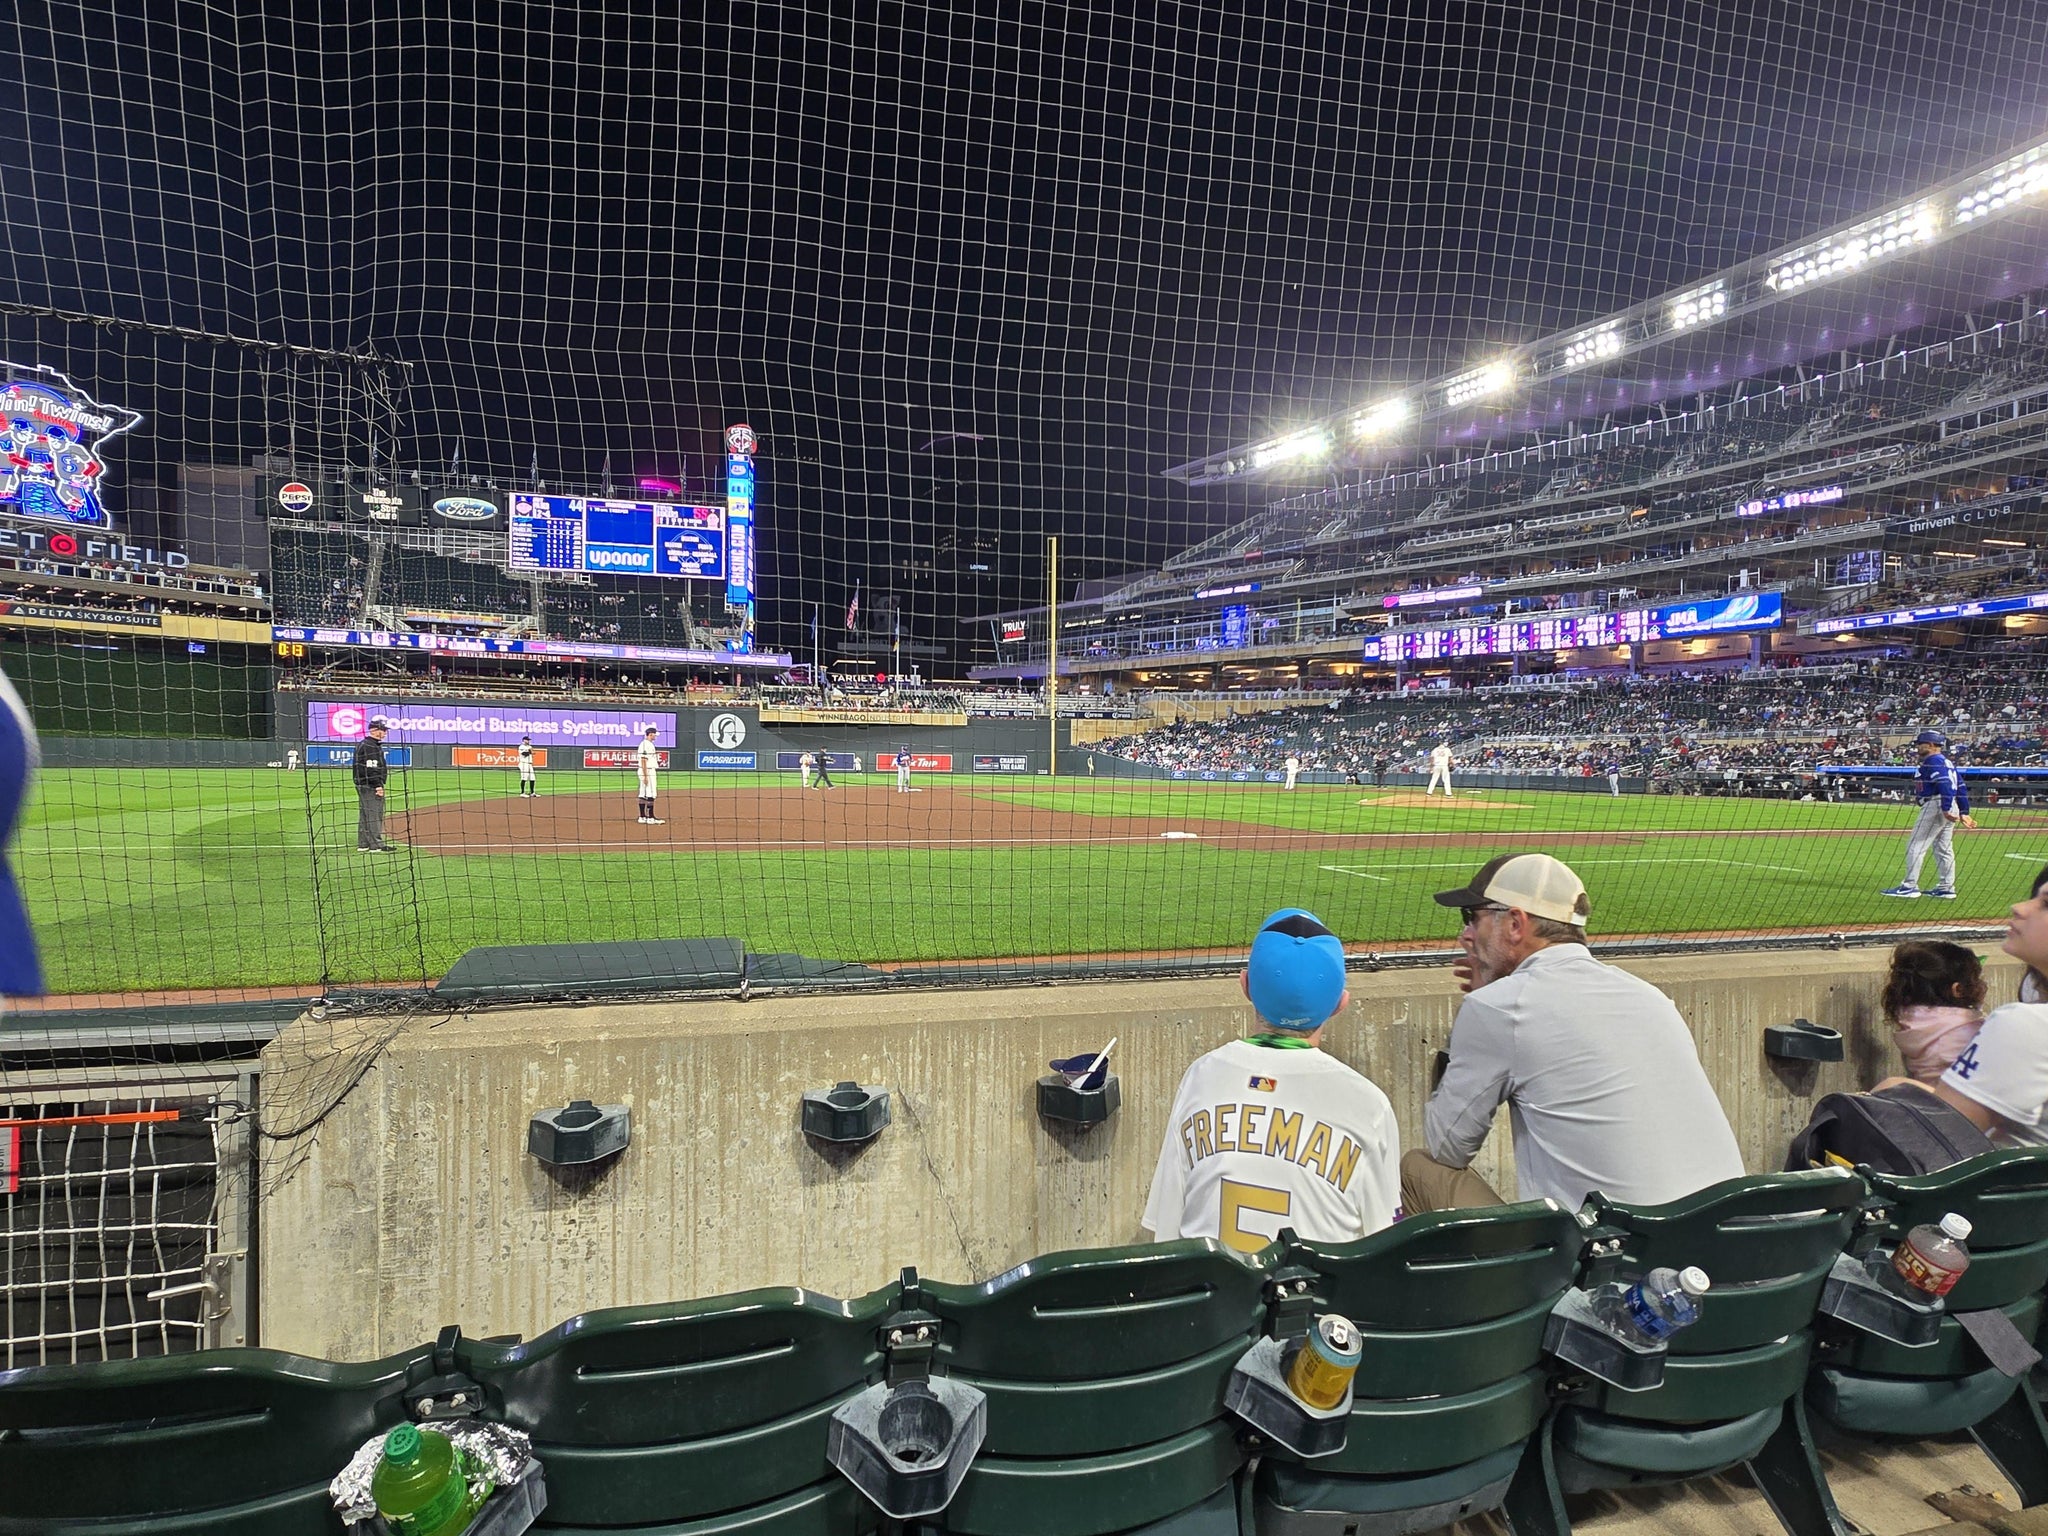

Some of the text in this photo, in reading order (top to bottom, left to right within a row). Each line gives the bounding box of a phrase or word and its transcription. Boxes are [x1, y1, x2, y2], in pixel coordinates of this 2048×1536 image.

[39, 398, 114, 431] Twins!
[281, 492, 311, 501] PEPSI
[446, 501, 484, 517] Ford
[1909, 504, 2012, 534] thrivent CLUB
[86, 540, 190, 569] FIELD
[589, 550, 650, 567] uponor
[28, 607, 73, 618] DELTA
[1666, 609, 1699, 626] JMA
[1002, 620, 1026, 632] TRULY
[457, 650, 497, 659] UNIVERSAL
[832, 674, 915, 683] TARGET FIEL
[818, 713, 866, 722] WINNEBAGO
[489, 717, 559, 735] Business
[562, 718, 631, 739] Systems,
[477, 752, 524, 765] Payco
[702, 756, 754, 765] PROGRESSIVE
[1180, 1103, 1363, 1194] FREEMAN
